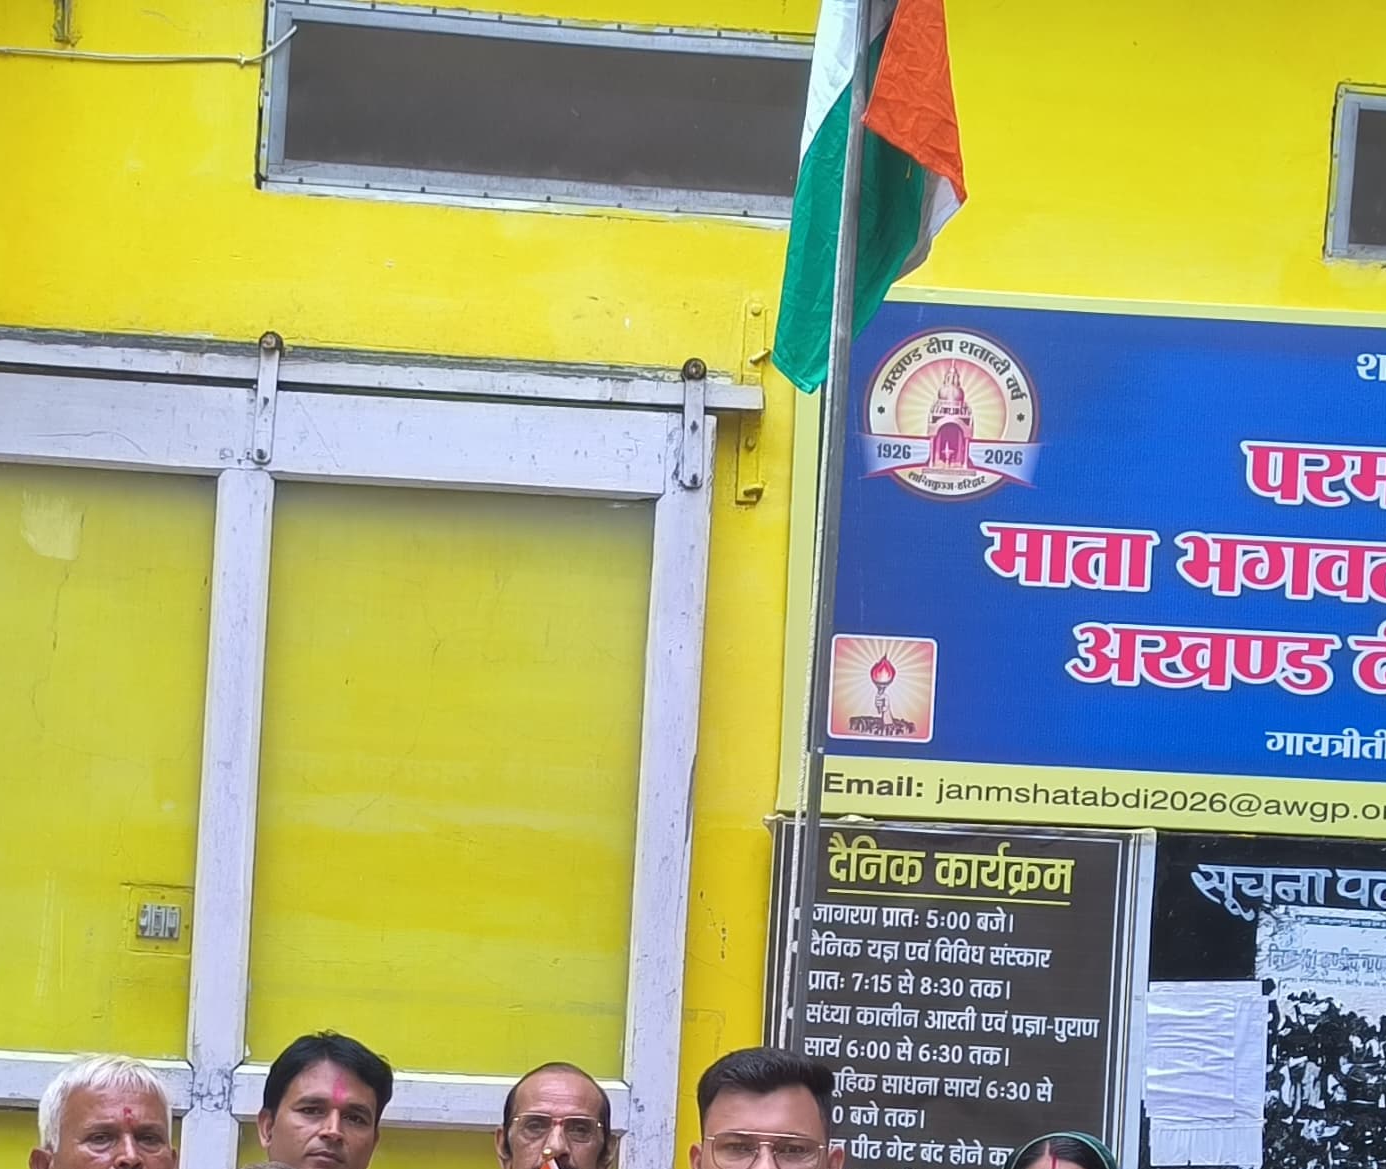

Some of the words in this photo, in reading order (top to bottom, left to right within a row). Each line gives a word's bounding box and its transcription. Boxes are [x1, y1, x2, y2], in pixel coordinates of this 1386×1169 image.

[881, 348, 923, 395] अखण्ड
[925, 337, 953, 355] दीप
[959, 340, 1011, 376] शताब्दी
[1005, 374, 1028, 400] वर्ष
[876, 443, 912, 460] 1926
[984, 449, 1024, 465] 2026
[981, 521, 1160, 591] माता
[1067, 622, 1341, 693] अखण्ड
[823, 772, 925, 799] Email:
[827, 832, 926, 886] दैनिक
[934, 842, 1075, 896] कार्यक्रम
[1191, 863, 1333, 921] सूचना
[813, 903, 877, 926] जागरण
[882, 907, 919, 929] प्रातः
[926, 910, 971, 932] 5:00
[810, 929, 863, 958] दैनिक
[867, 940, 900, 963] यज्ञ
[904, 938, 932, 962] एवं
[935, 937, 986, 965] विविध
[989, 942, 1052, 968] संस्कार
[852, 973, 892, 994] 7:15
[898, 969, 915, 995] से
[920, 976, 963, 998] 8:30
[805, 1001, 851, 1025] संध्या
[856, 1002, 919, 1029] कालीन
[924, 1006, 977, 1032] आरती
[981, 1010, 1009, 1033] एवं
[804, 1035, 843, 1058] सायं
[846, 1039, 891, 1061] 6:00
[896, 1036, 913, 1062] से
[918, 1043, 963, 1065] 6:30
[882, 1073, 940, 1097] साधना
[944, 1075, 982, 1099] सायं
[986, 1080, 1031, 1101] 6:30
[1036, 1076, 1054, 1102] से
[850, 1101, 880, 1126] बजे
[851, 1133, 882, 1160] पीठ
[886, 1135, 917, 1162] गेट
[920, 1139, 945, 1164] बंद
[949, 1138, 984, 1166] होने
